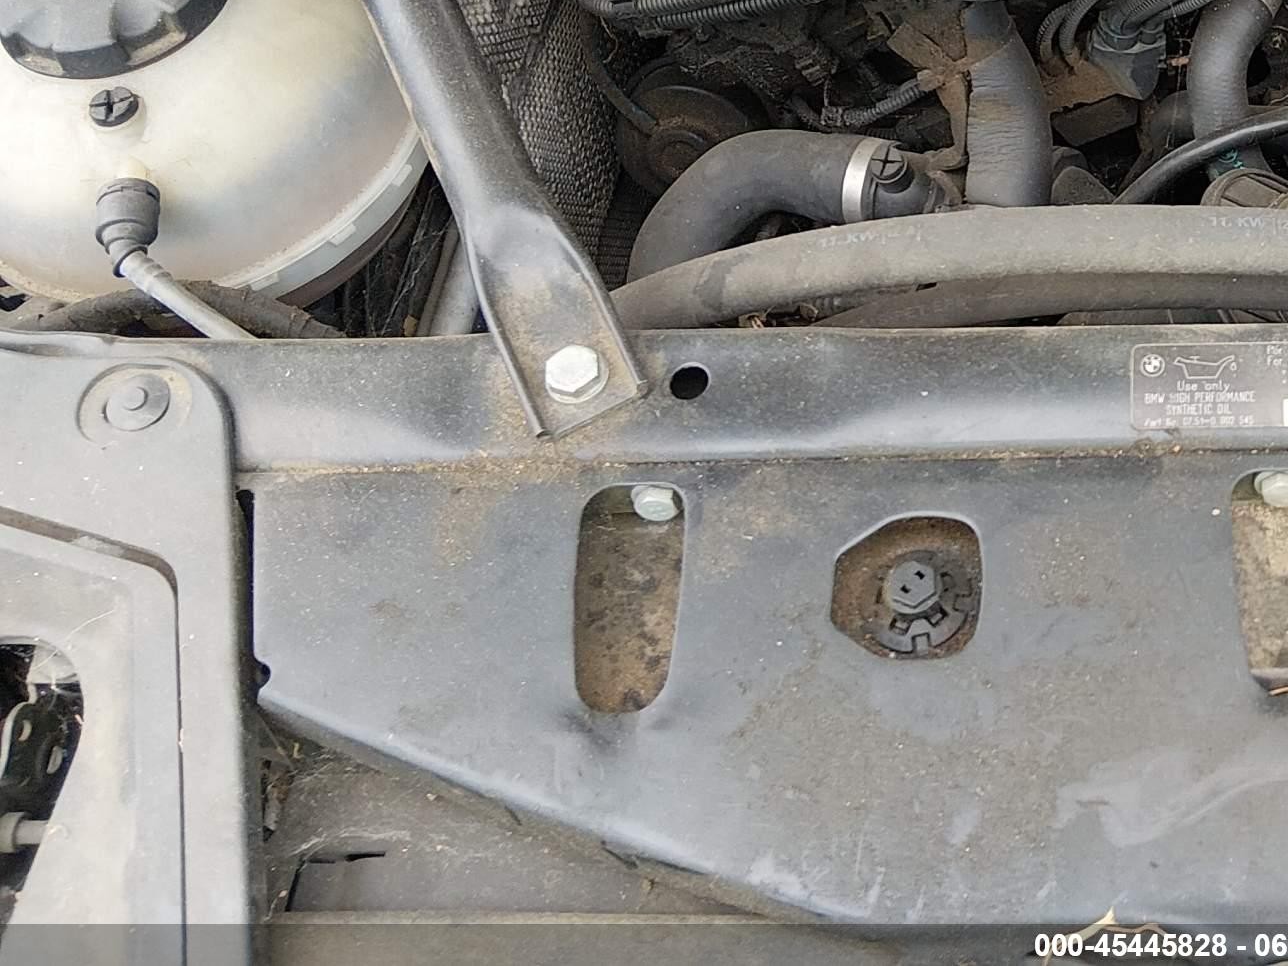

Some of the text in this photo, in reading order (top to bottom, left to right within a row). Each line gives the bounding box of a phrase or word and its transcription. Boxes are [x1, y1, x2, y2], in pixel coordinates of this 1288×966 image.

[1266, 356, 1283, 366] For
[1176, 379, 1231, 393] Use only
[1144, 390, 1256, 404] BMW HIGH PERFORMANCE
[1166, 404, 1233, 416] SYNTHETIC OIL
